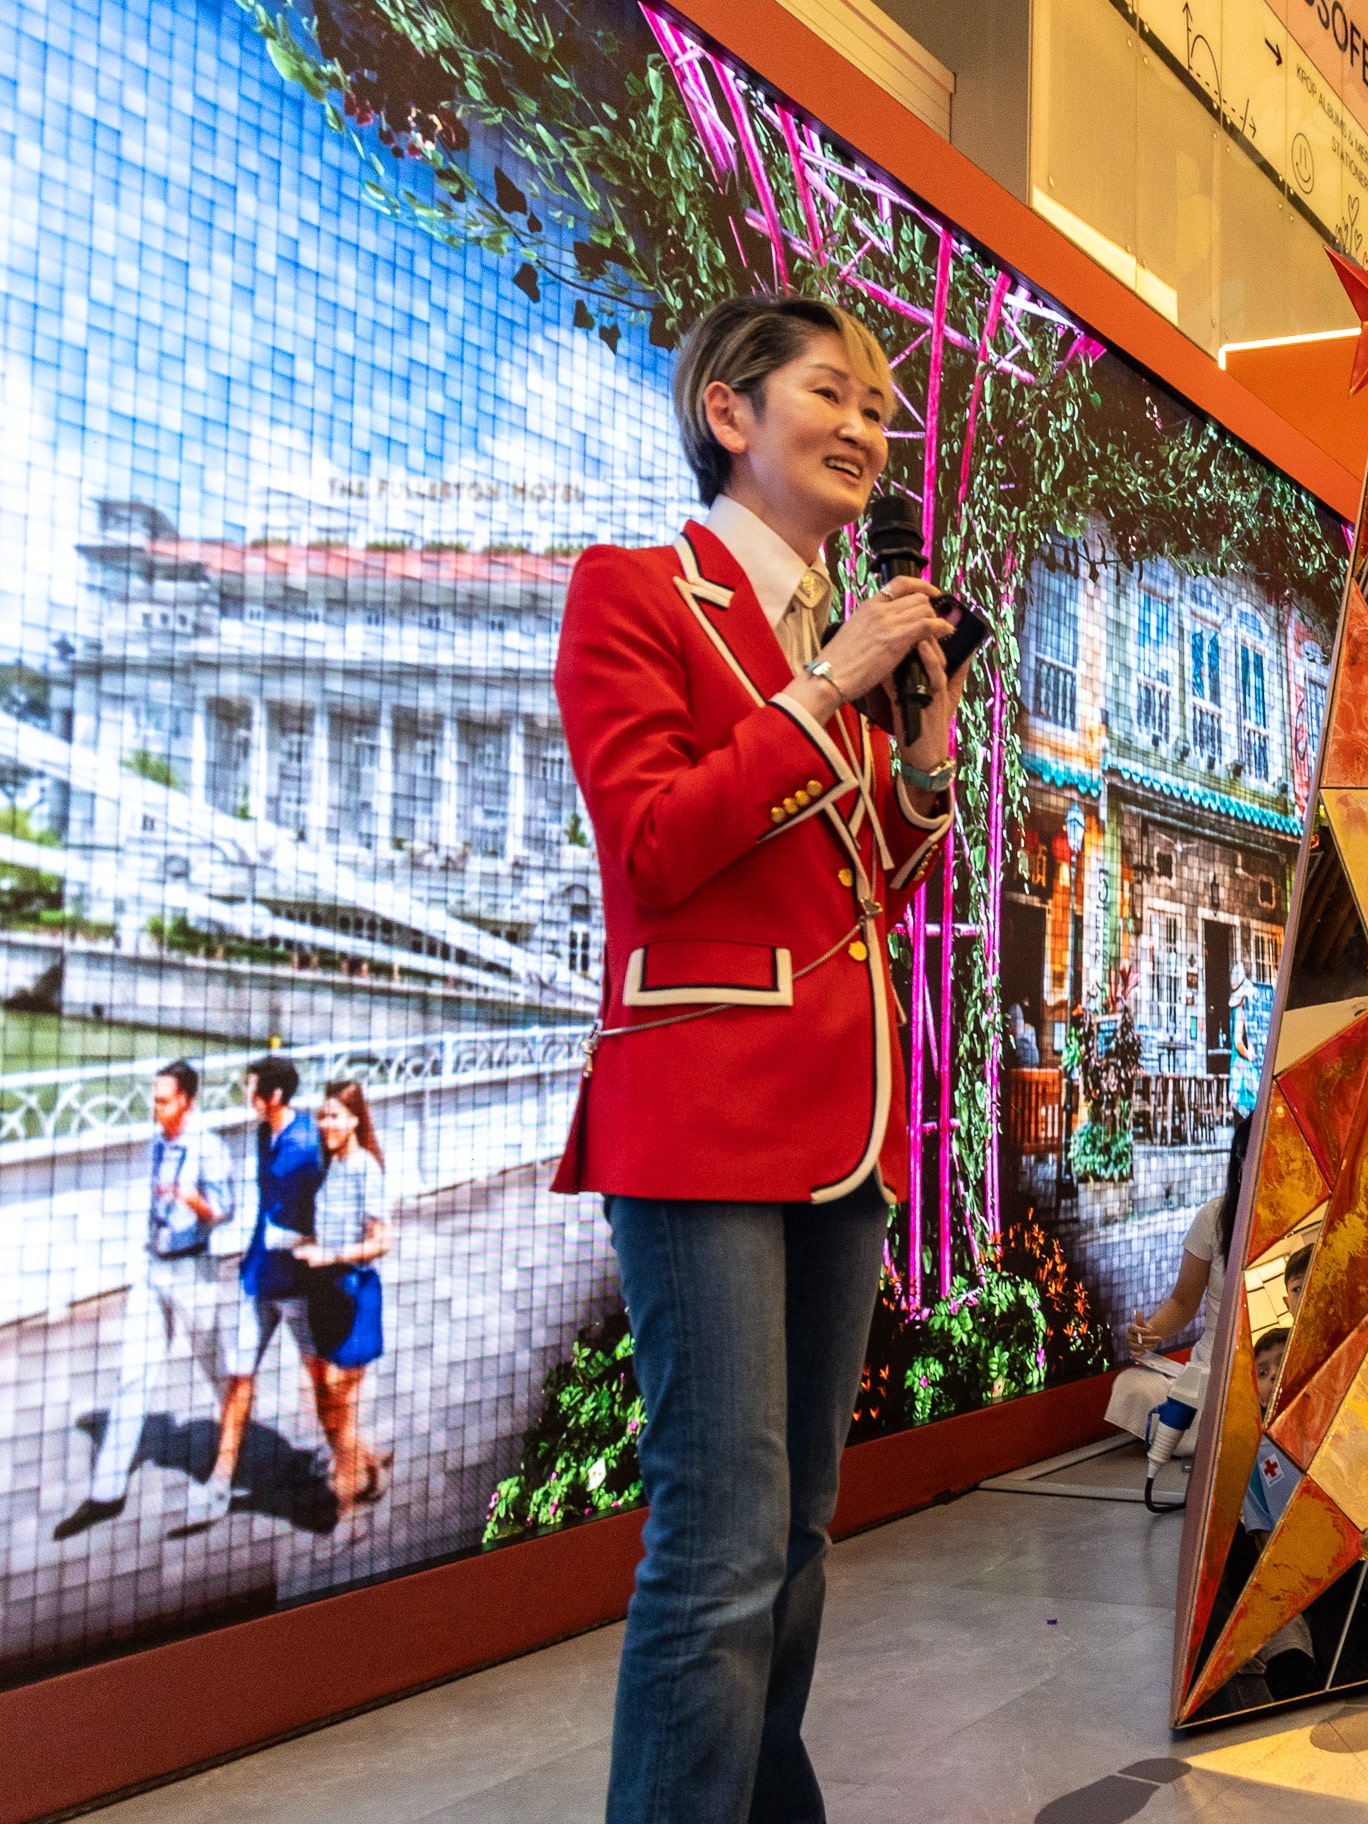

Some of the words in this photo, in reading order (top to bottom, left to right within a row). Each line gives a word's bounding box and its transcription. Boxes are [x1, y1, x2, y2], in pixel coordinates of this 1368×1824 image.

[1296, 63, 1317, 97] KPOP
[1318, 93, 1347, 138] ALBUMS
[329, 477, 365, 499] THE
[377, 480, 499, 502] FULLERTON
[511, 482, 586, 504] HOTEL
[916, 685, 927, 695] 2
